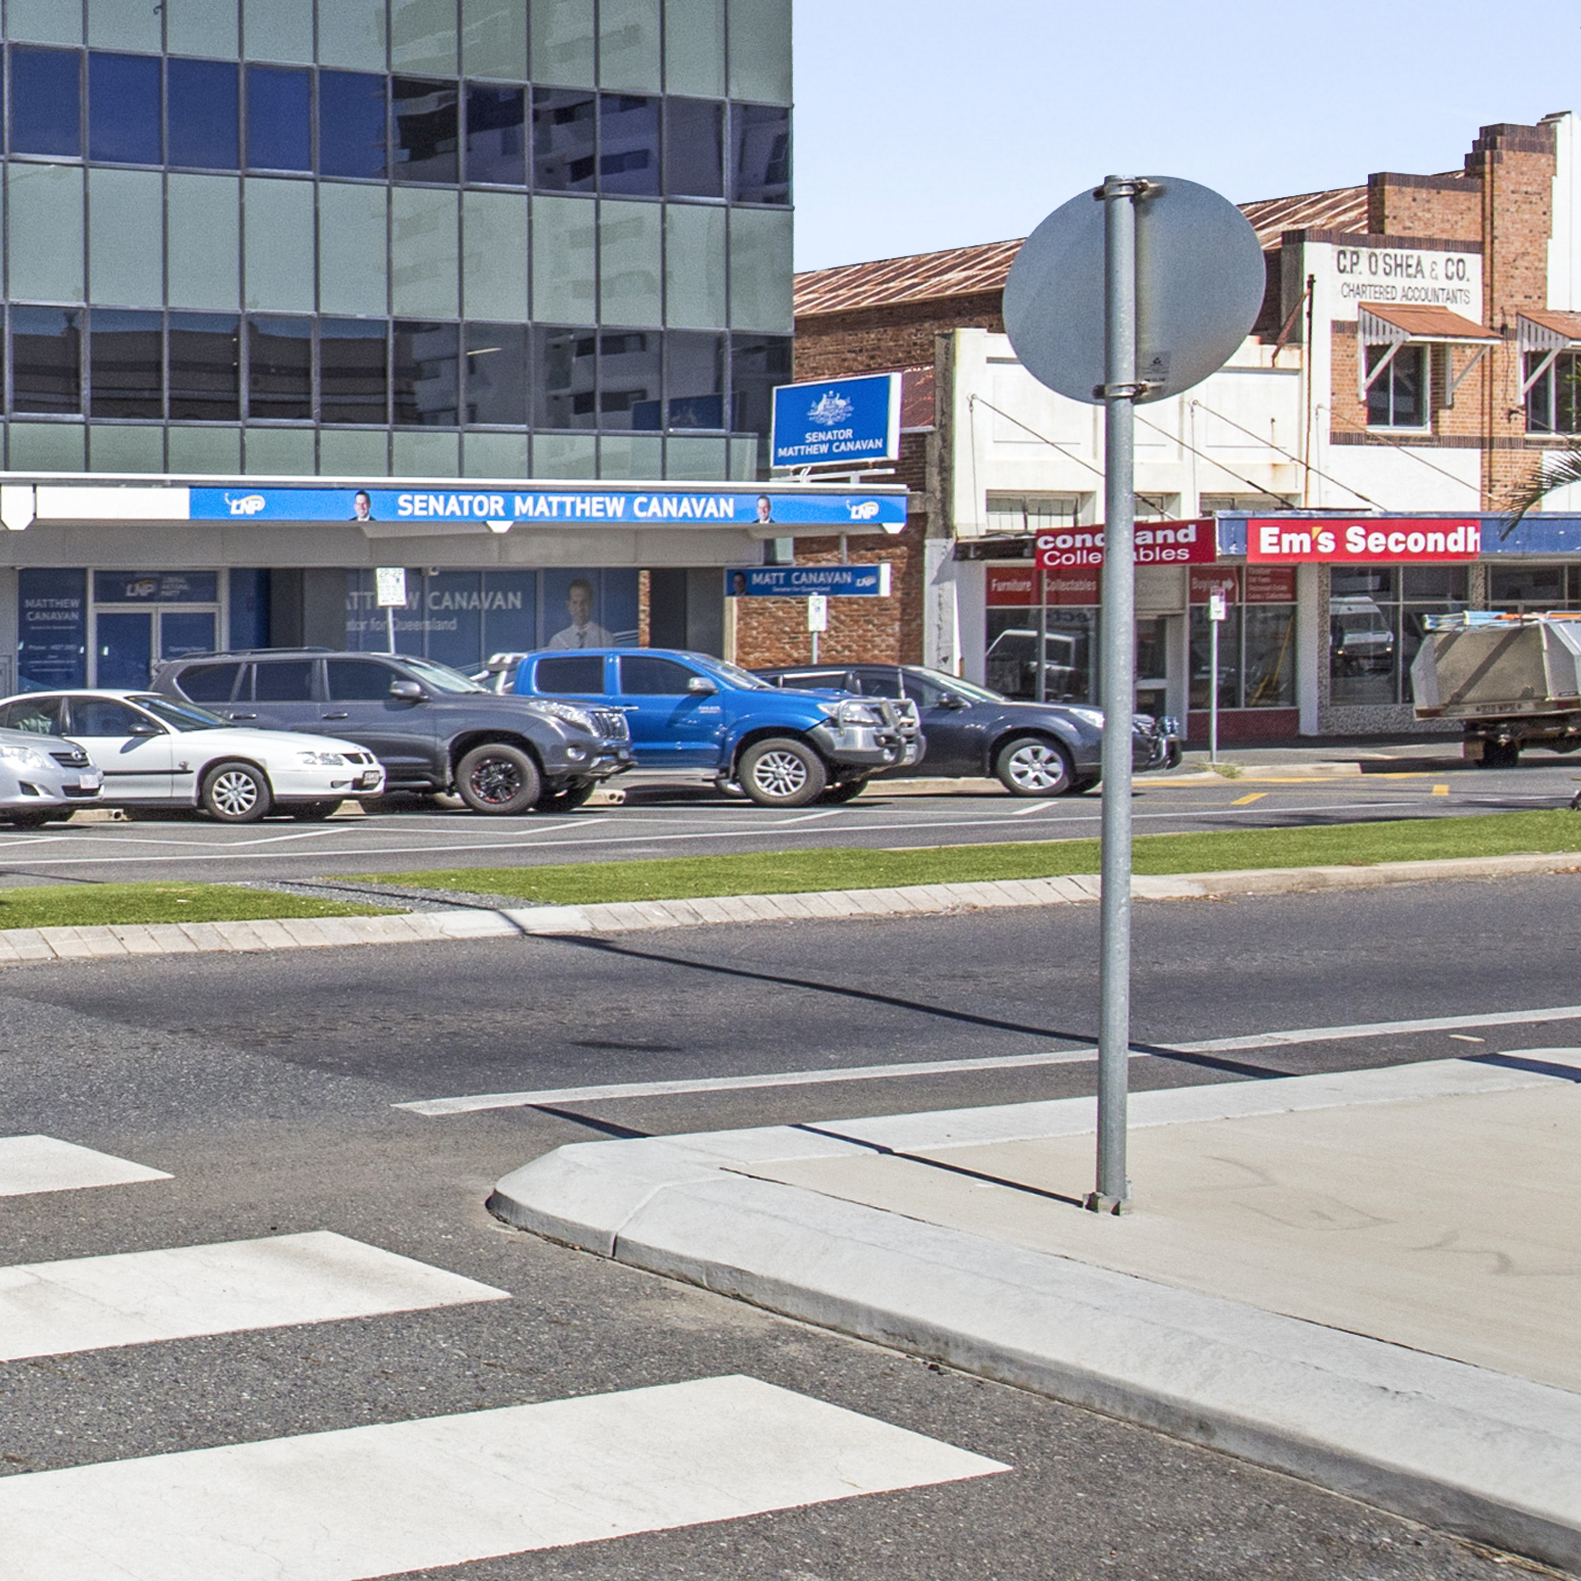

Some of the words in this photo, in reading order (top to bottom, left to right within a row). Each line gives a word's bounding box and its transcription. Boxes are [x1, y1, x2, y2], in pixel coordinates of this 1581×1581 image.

[1430, 261, 1439, 280] &
[1445, 257, 1470, 282] CO.
[1341, 282, 1398, 301] CHARTERED
[1400, 286, 1471, 305] ACCOUNTANTS
[805, 429, 853, 443] SENATOR
[778, 444, 829, 457] MATTHEW
[832, 438, 883, 453] CANAVAN
[229, 495, 266, 515] LNP
[398, 494, 505, 516] SENATOR
[514, 496, 625, 517] MATTHEW
[633, 497, 735, 518] CANAVAN
[849, 502, 879, 519] LNP
[1038, 524, 1197, 550] condand
[1259, 526, 1336, 554] Em's
[1345, 526, 1481, 553] Secondh
[125, 580, 157, 597] LNP
[751, 573, 785, 585] MATT
[791, 572, 851, 585] CANAVAN
[855, 576, 877, 587] LNP
[991, 579, 1033, 591] Furniture
[1045, 580, 1098, 591] Collectables
[25, 598, 80, 609] MATTHEW
[428, 591, 522, 610] CANAVAN
[26, 611, 79, 622] CANAVAN
